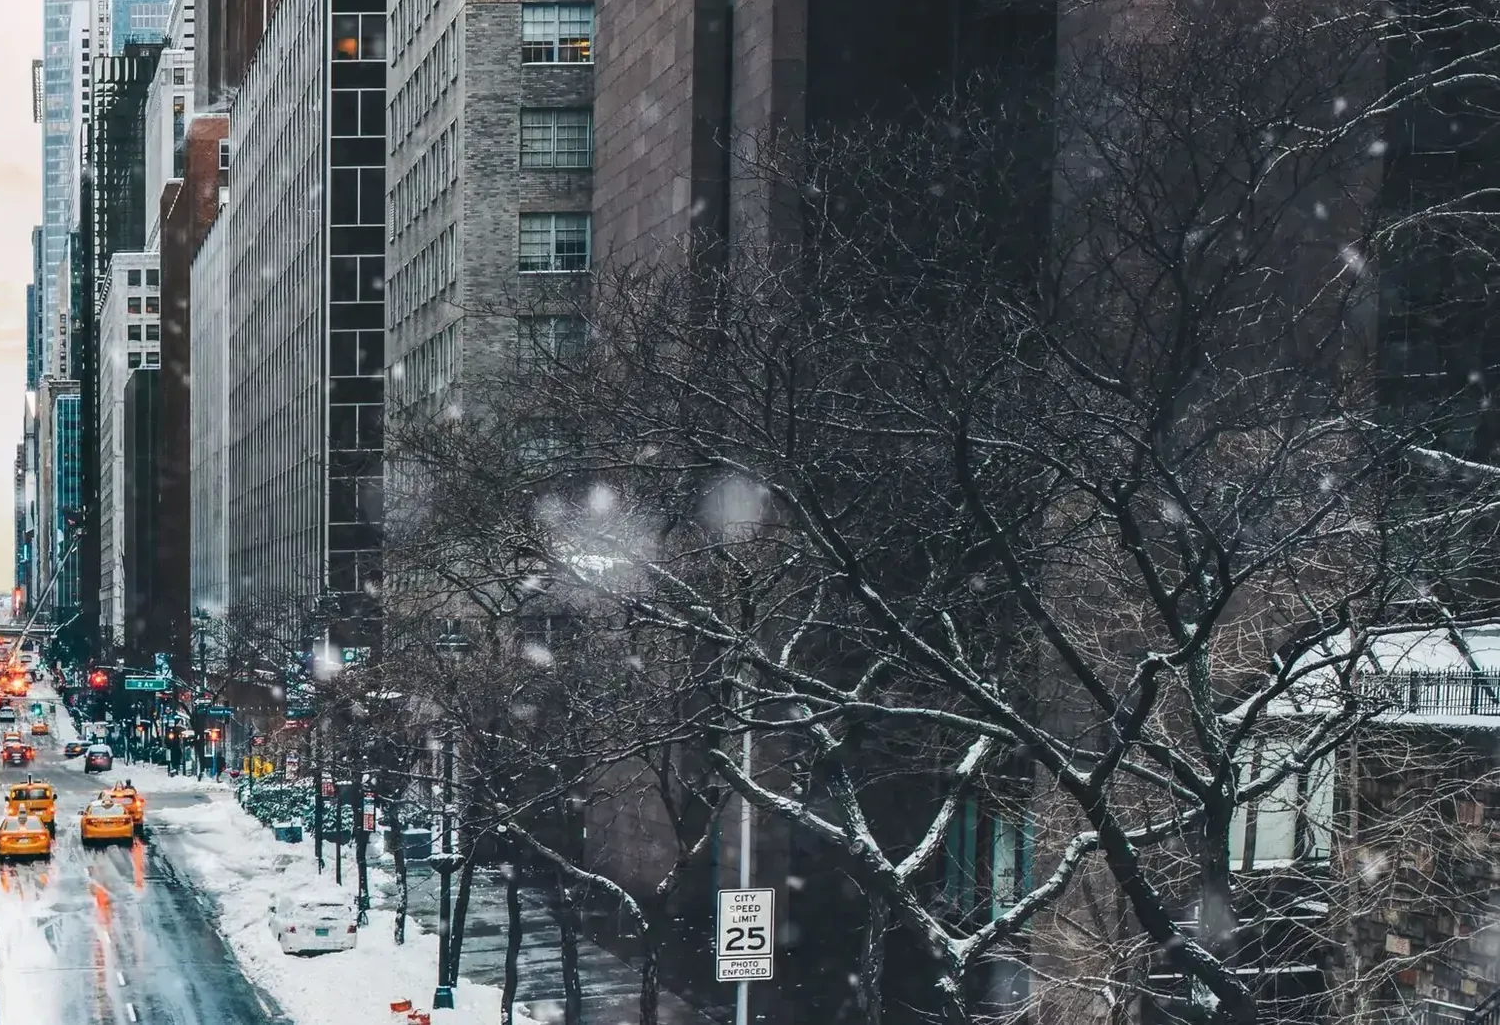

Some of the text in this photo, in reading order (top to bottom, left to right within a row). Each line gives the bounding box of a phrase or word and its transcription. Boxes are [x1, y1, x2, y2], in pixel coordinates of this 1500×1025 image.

[734, 895, 756, 903] CITY
[729, 905, 761, 913] SPEED
[732, 915, 758, 923] LIMIT
[725, 927, 766, 951] 25
[730, 960, 759, 968] PHOTO
[722, 968, 767, 976] ENFORCED
